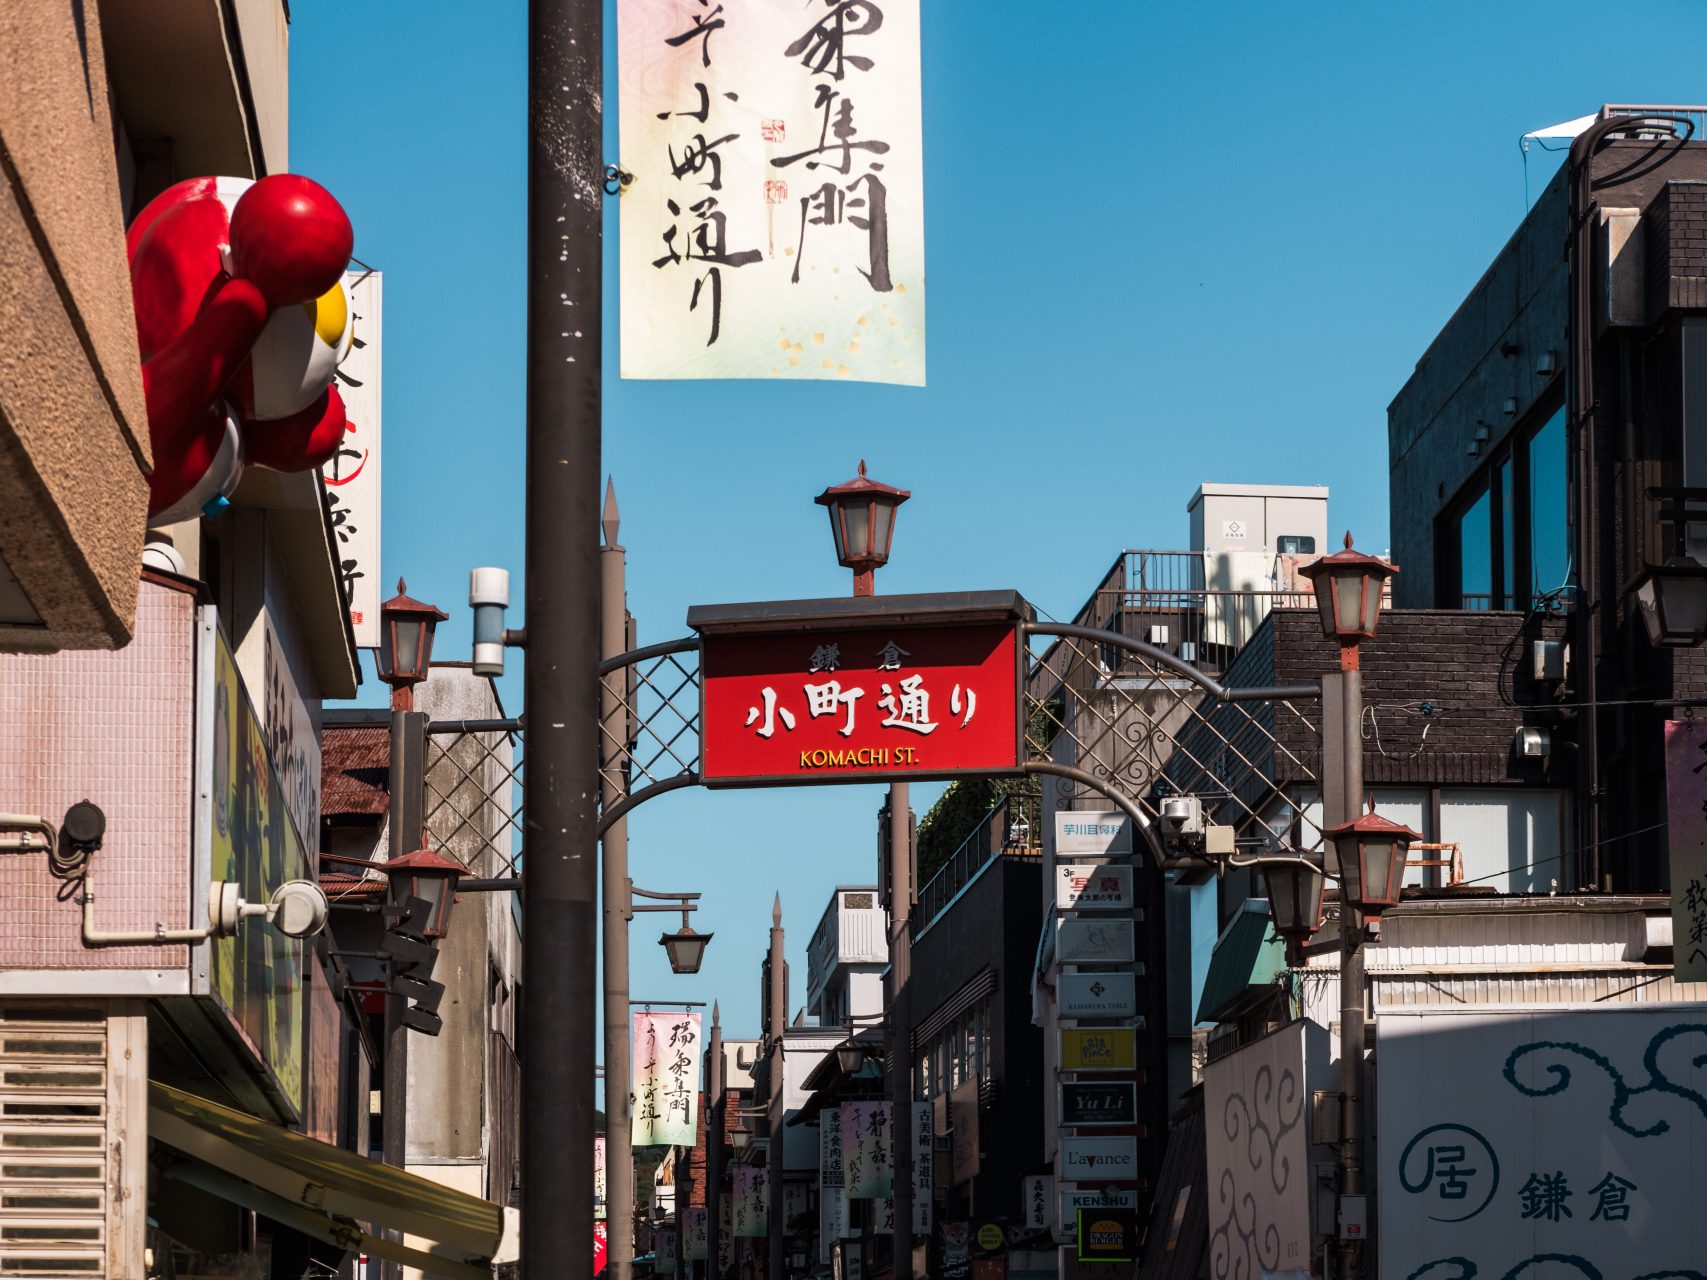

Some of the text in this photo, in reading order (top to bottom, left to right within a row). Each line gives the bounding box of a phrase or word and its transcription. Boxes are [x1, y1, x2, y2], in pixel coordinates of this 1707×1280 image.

[652, 0, 764, 347] そ小町通り
[808, 639, 912, 673] 鎌倉
[744, 673, 978, 739] 小町通り
[799, 747, 920, 768] KOMACHI ST.
[1063, 868, 1075, 878] 3F
[1069, 876, 1121, 892] 写真
[1107, 1002, 1129, 1010] TABLE
[1075, 1094, 1125, 1110] Yu Li
[918, 1109, 931, 1147] 古美術
[918, 1152, 931, 1190] 茶道具
[1072, 1196, 1129, 1207] KENSHU
